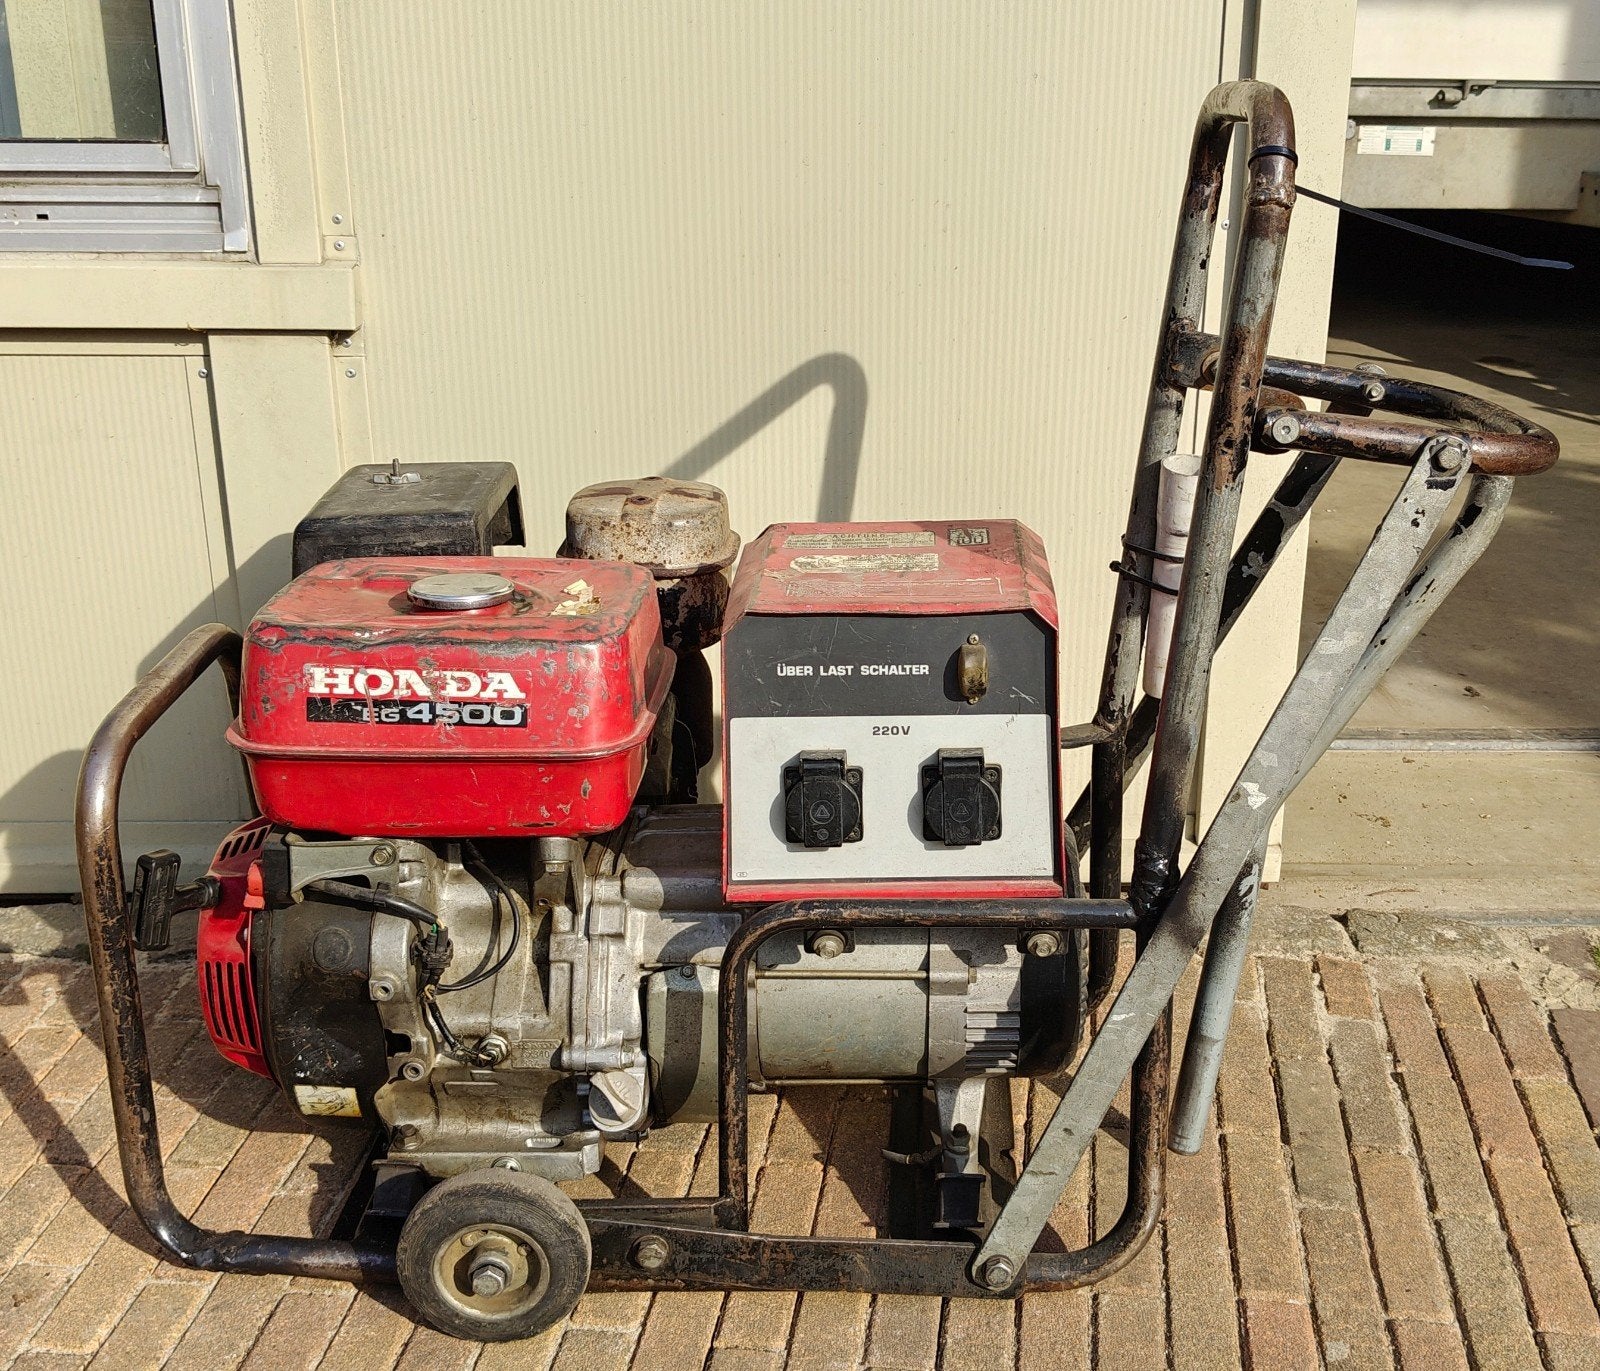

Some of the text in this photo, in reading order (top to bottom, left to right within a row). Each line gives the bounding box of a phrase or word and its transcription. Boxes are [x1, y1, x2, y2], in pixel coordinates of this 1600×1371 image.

[776, 663, 930, 677] ÜBER LAST SCHALTER
[308, 666, 526, 699] HONDA
[362, 702, 524, 725] EG 4500
[872, 725, 911, 736] 220V
